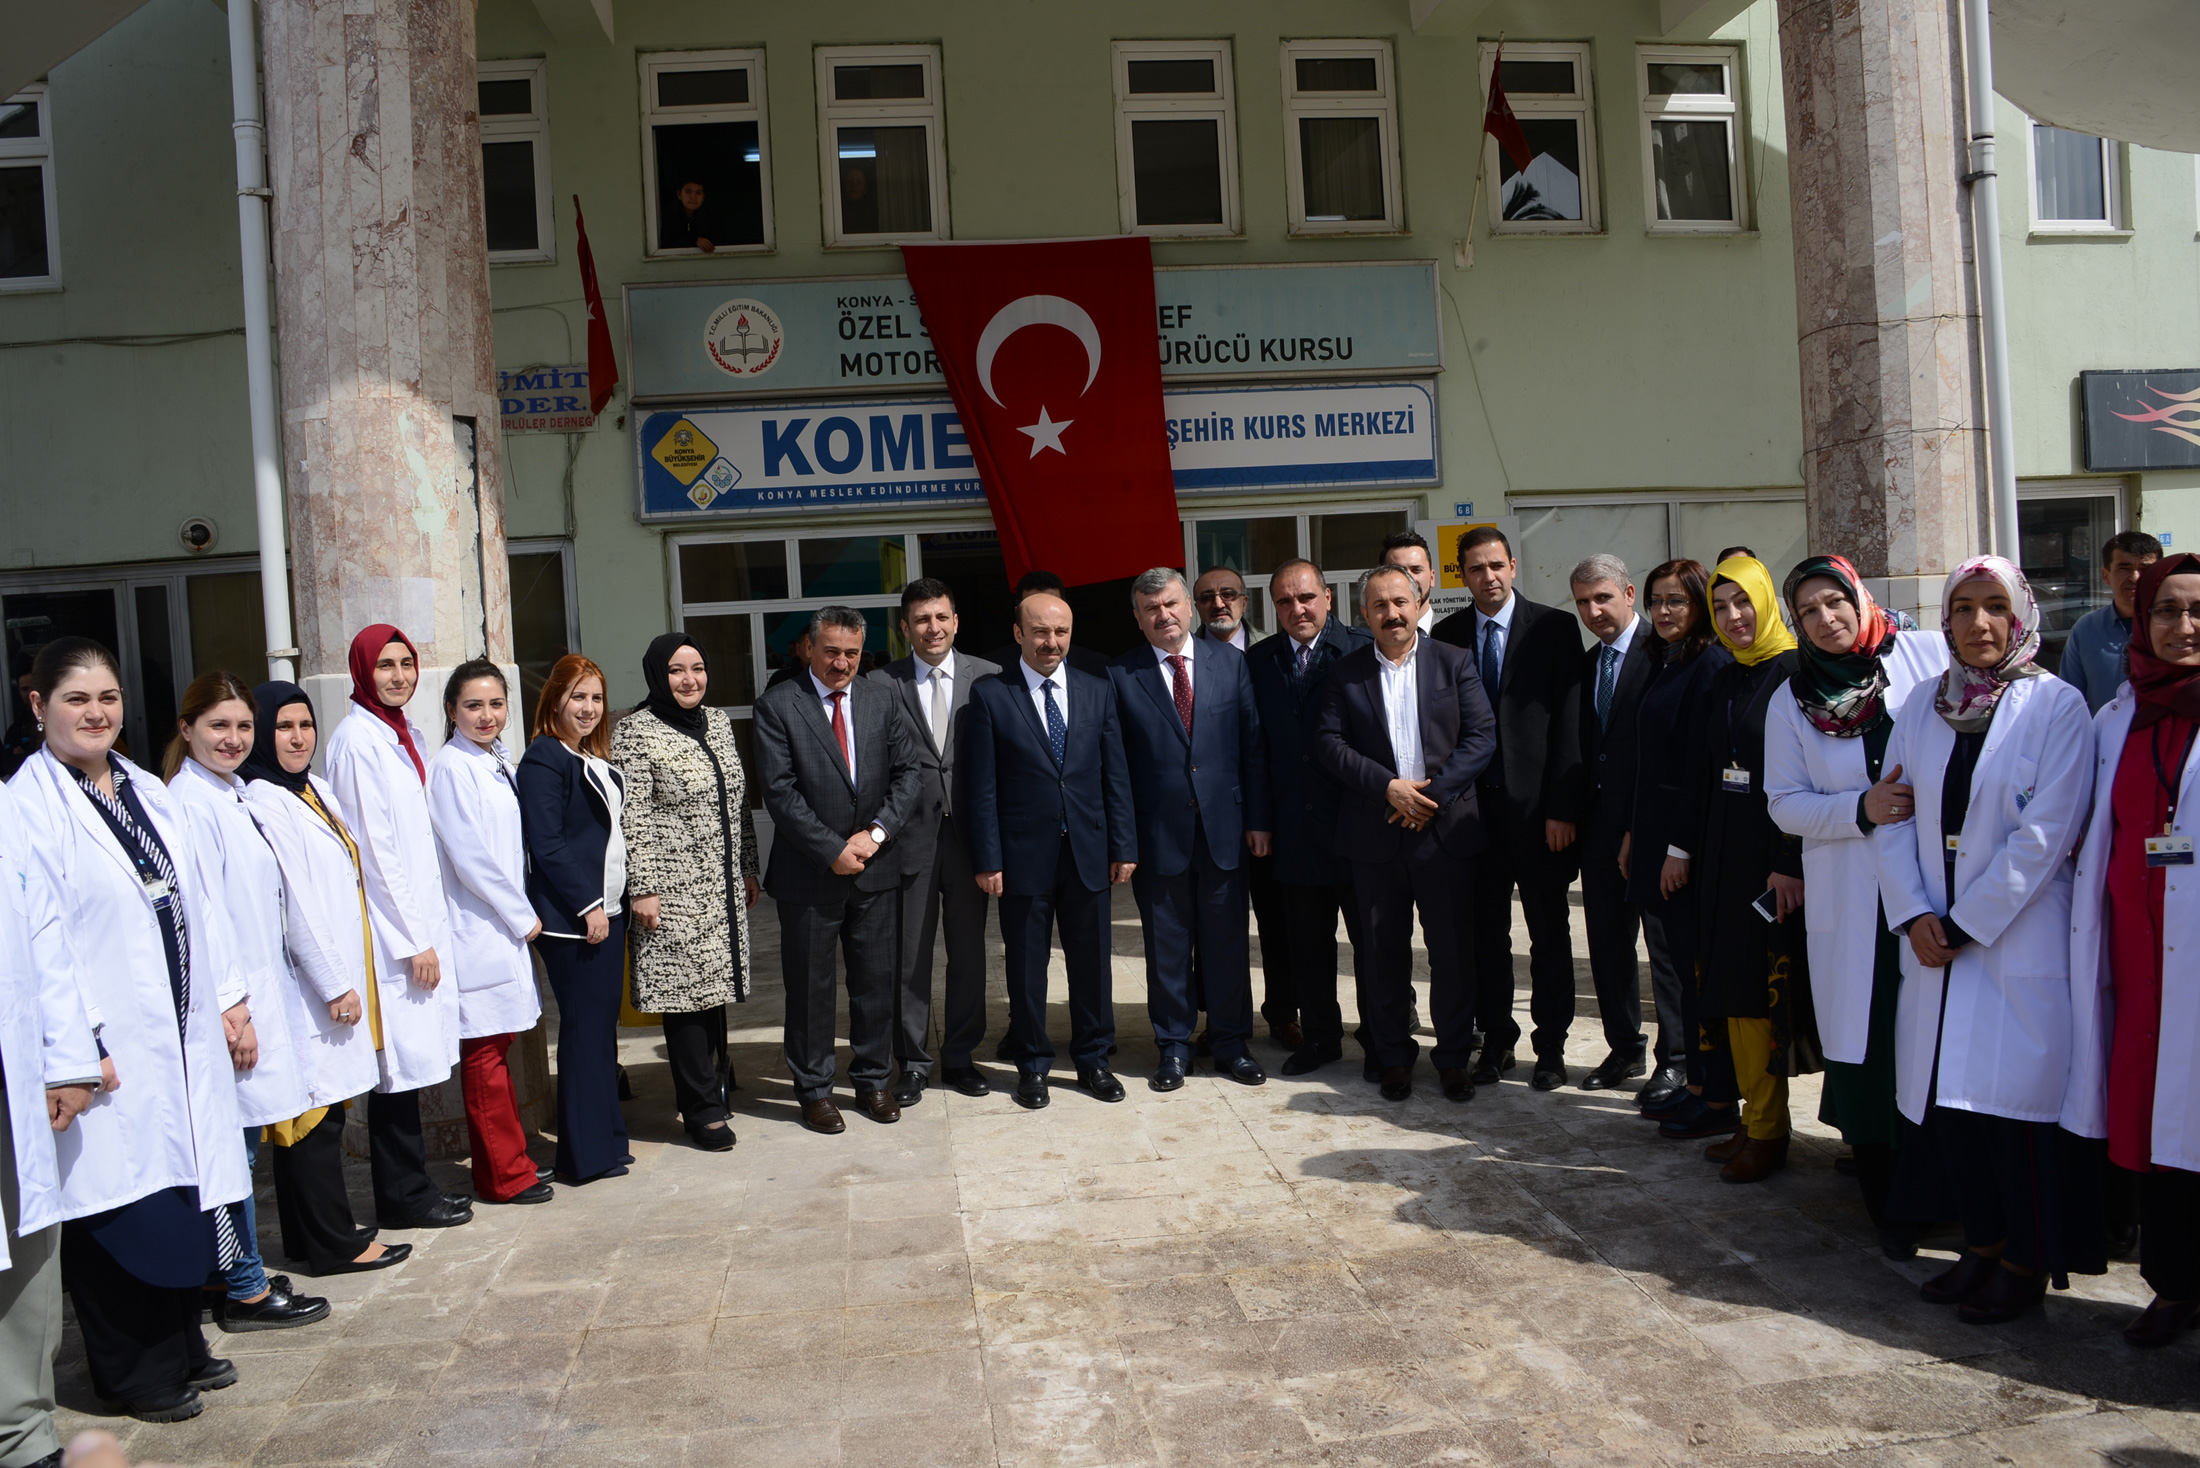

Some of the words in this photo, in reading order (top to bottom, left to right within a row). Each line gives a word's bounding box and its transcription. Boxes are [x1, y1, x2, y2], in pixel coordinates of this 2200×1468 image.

[837, 296, 893, 308] KONYA
[750, 305, 778, 334] BAKANLIĞI
[839, 311, 912, 340] ÖZEL
[1260, 336, 1354, 362] KURSU
[761, 412, 975, 477] KOME
[1244, 414, 1306, 440] KURS
[1314, 404, 1415, 437] MERKEZİ
[665, 453, 705, 463] BÜYÜKŞEHİR
[757, 490, 803, 501] KONYA
[810, 487, 864, 498] MESLEK
[870, 483, 947, 496] EDİNDİRME
